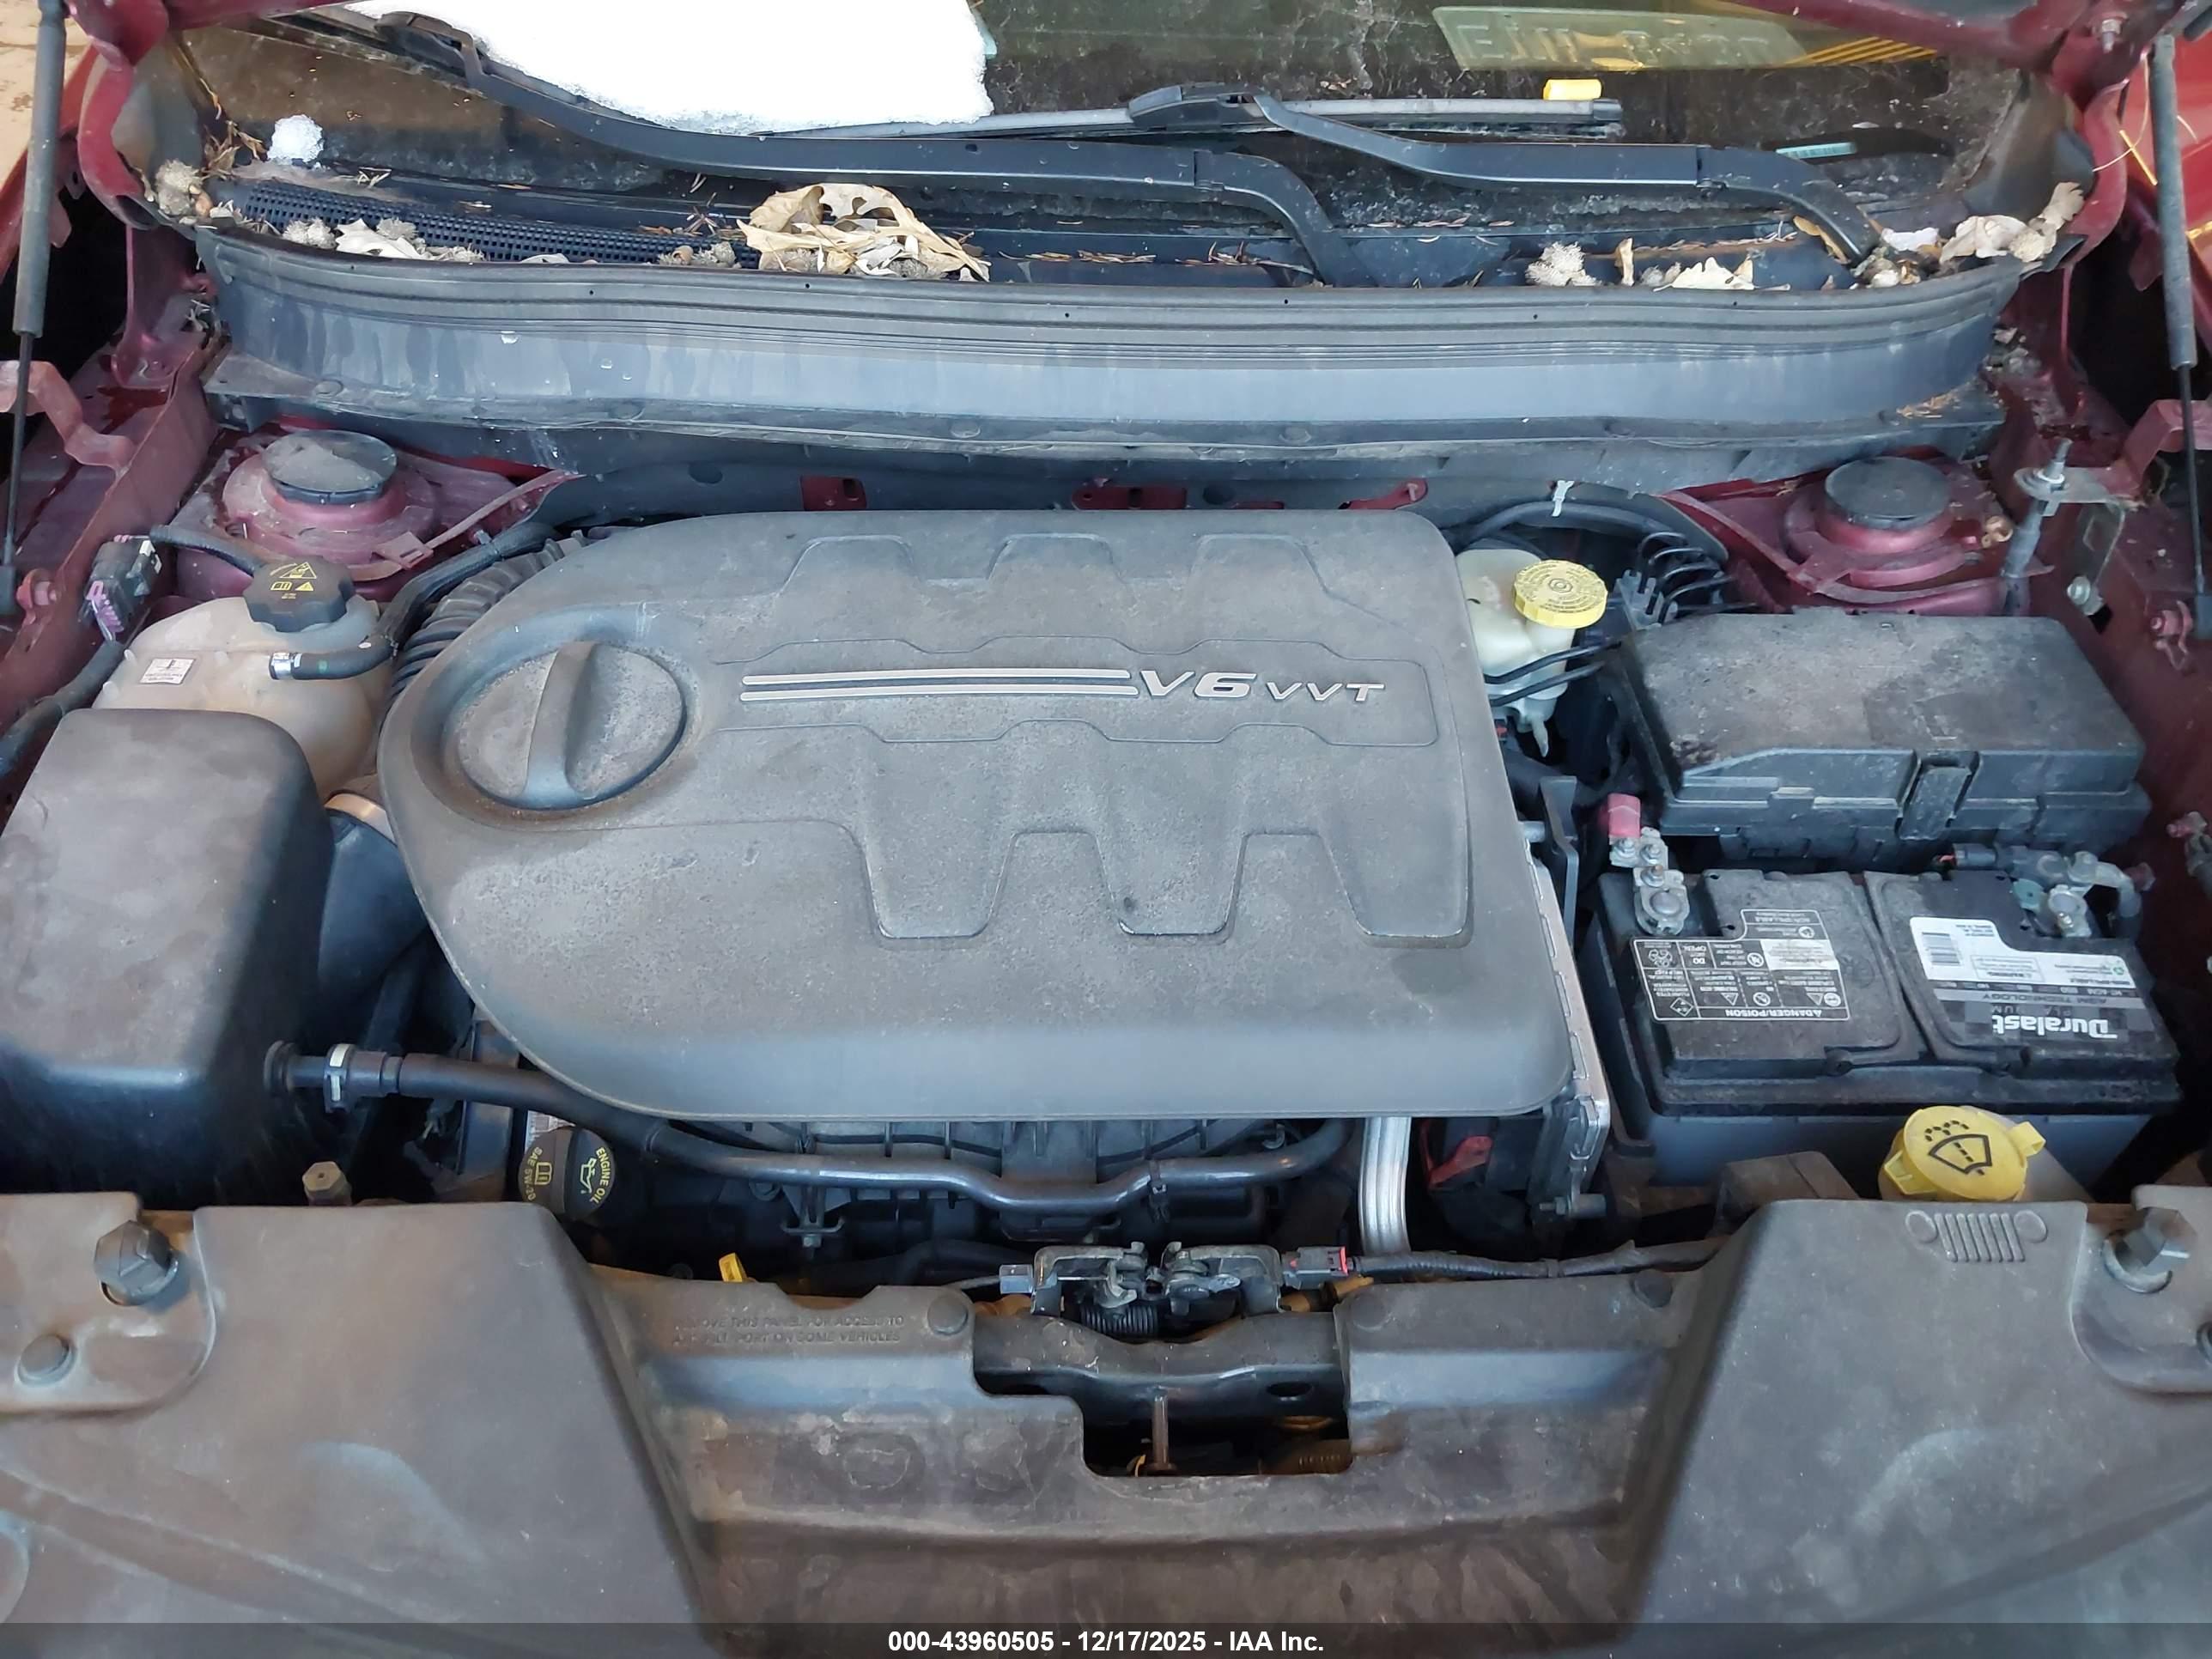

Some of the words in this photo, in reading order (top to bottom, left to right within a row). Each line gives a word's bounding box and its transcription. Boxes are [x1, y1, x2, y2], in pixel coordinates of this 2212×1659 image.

[1140, 670, 1257, 698] V6
[1267, 682, 1384, 702] VVT
[1725, 1009, 1814, 1018] DANGER/POISON
[1991, 1014, 2118, 1039] Duralast
[527, 1146, 543, 1167] SAE
[596, 1147, 611, 1186] ENGINE
[589, 1188, 606, 1204] OIL
[884, 1314, 904, 1326] TO
